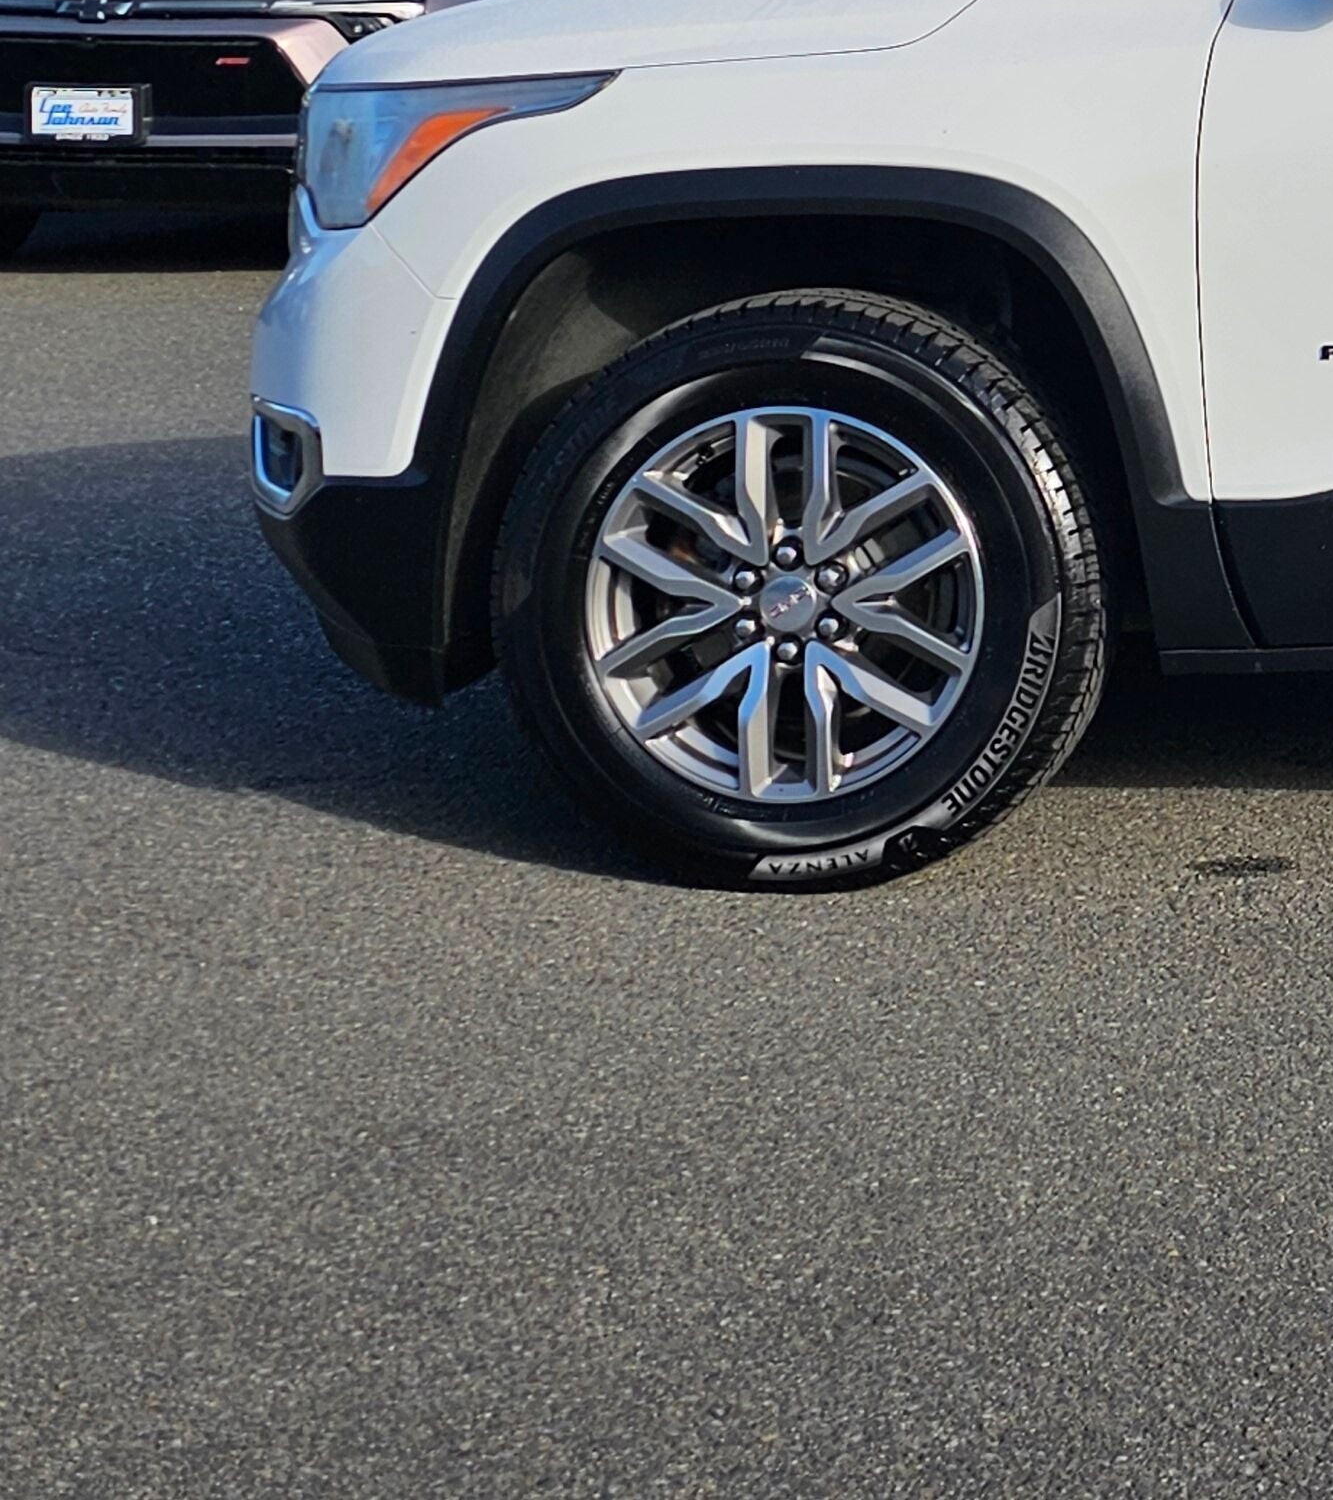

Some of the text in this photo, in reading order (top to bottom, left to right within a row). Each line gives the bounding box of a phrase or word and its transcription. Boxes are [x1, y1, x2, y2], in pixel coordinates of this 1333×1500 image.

[39, 91, 73, 114] Lee
[42, 108, 120, 126] Johnson
[940, 630, 1056, 817] BRIDGESTONE
[768, 848, 870, 875] ALENZA
